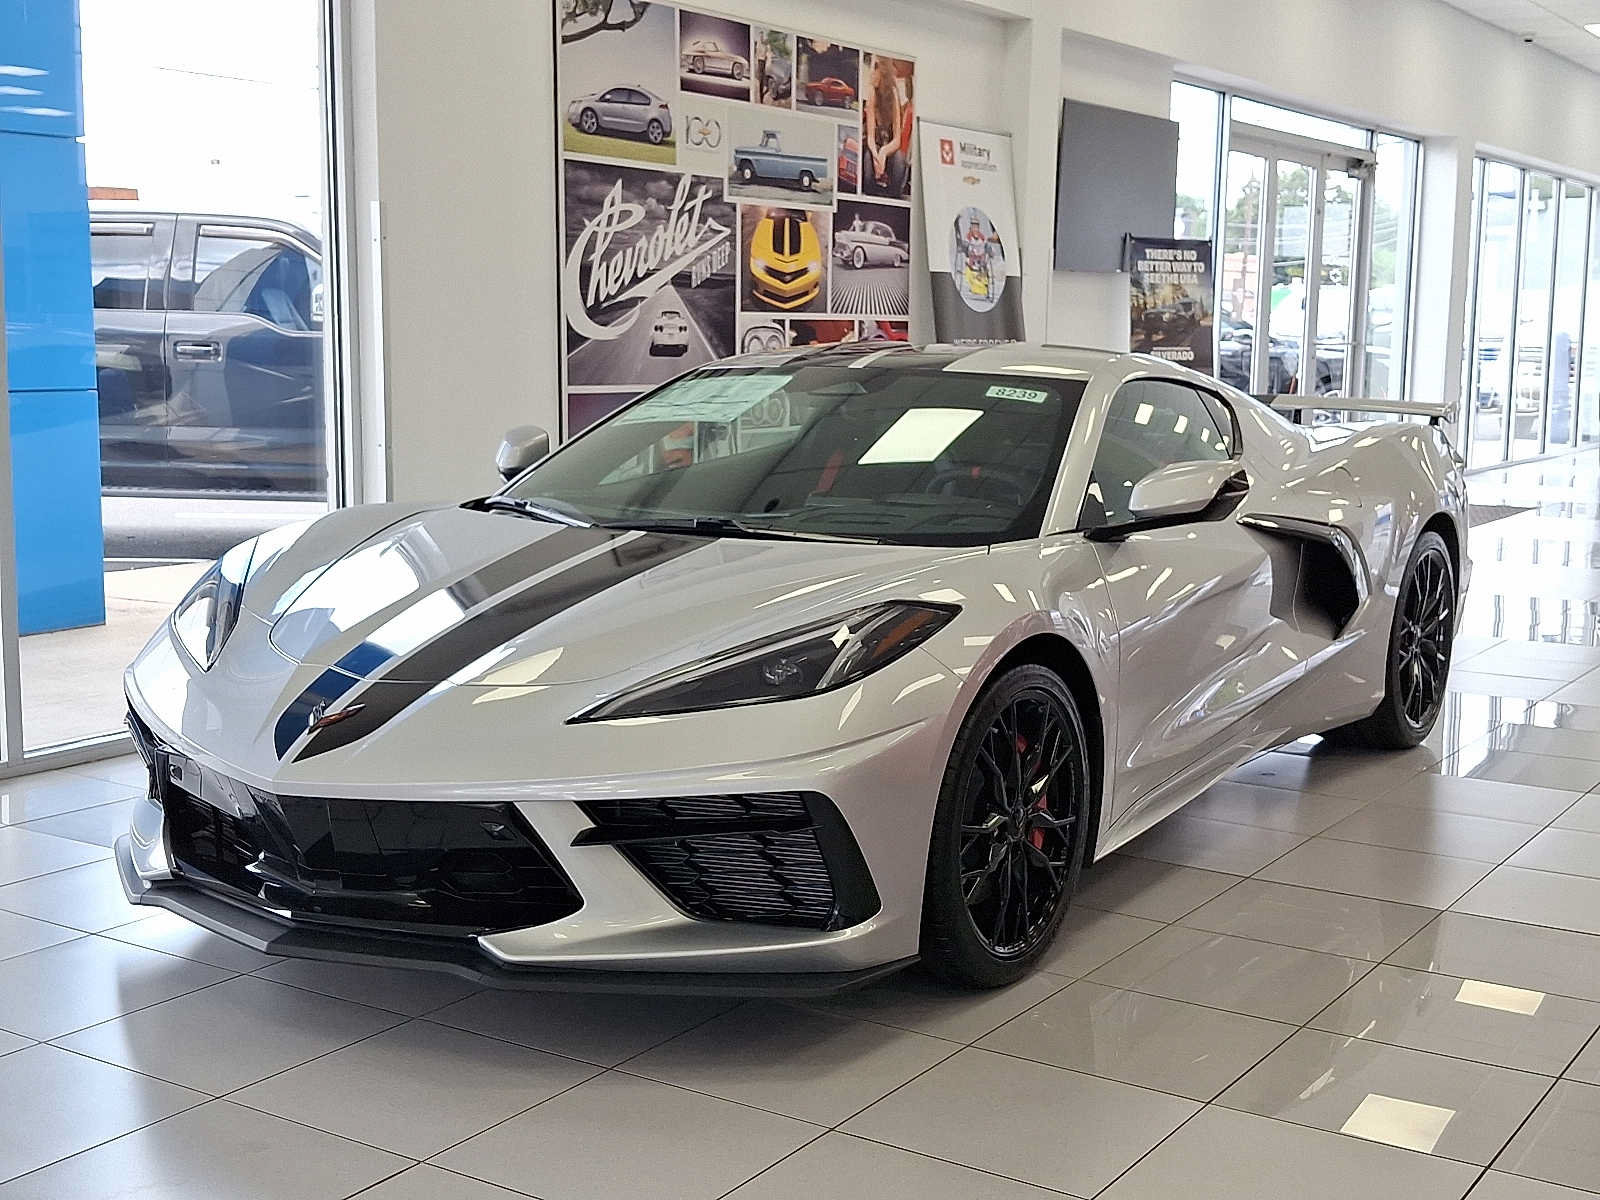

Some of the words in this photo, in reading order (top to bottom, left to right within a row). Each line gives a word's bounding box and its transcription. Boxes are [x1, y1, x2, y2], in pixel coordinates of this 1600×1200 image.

[566, 173, 731, 340] Chevrolet
[1145, 248, 1183, 261] THERE'S
[1183, 250, 1198, 261] NO
[1137, 260, 1172, 273] BETTER
[1172, 261, 1193, 273] WAY
[1193, 262, 1206, 273] TO
[995, 388, 1038, 400] 8239
